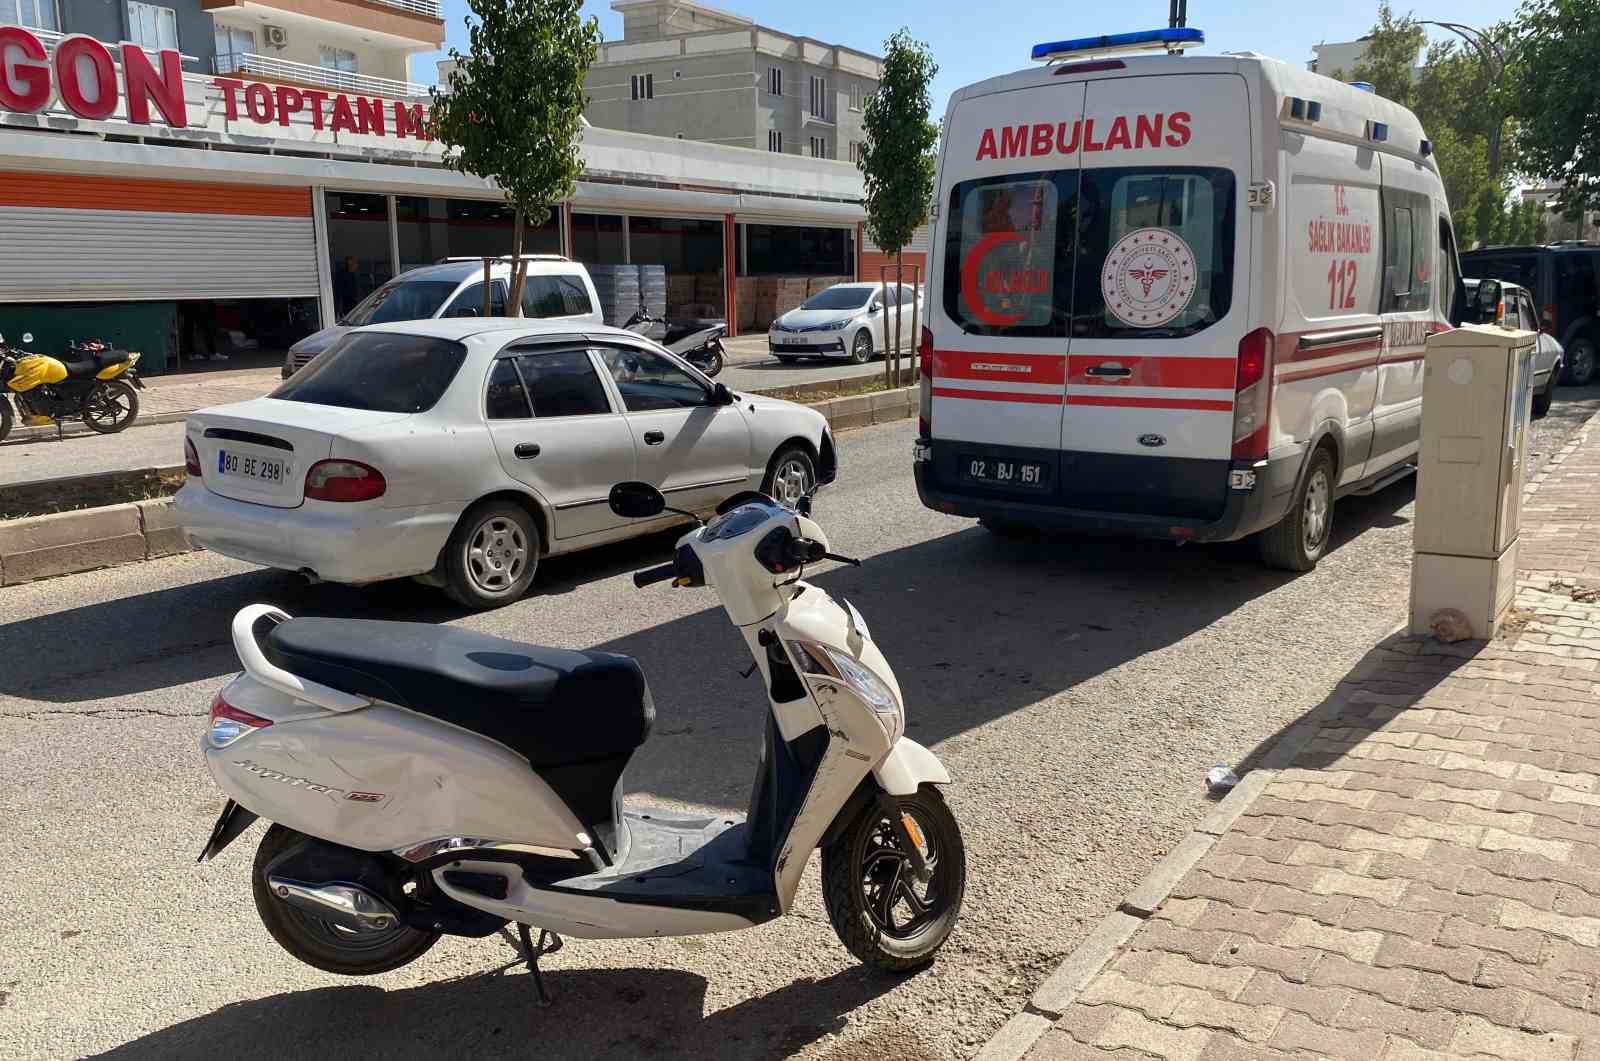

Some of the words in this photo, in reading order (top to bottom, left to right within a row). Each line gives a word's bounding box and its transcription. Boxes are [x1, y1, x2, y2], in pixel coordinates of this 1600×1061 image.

[214, 77, 386, 137] TOPTAN
[975, 110, 1193, 161] AMBULANS
[1327, 259, 1358, 310] 112
[224, 455, 238, 472] 80
[244, 458, 258, 477] BE
[260, 461, 280, 481] 298
[970, 460, 986, 478] 02
[997, 462, 1014, 480] BJ
[1021, 464, 1041, 483] 151
